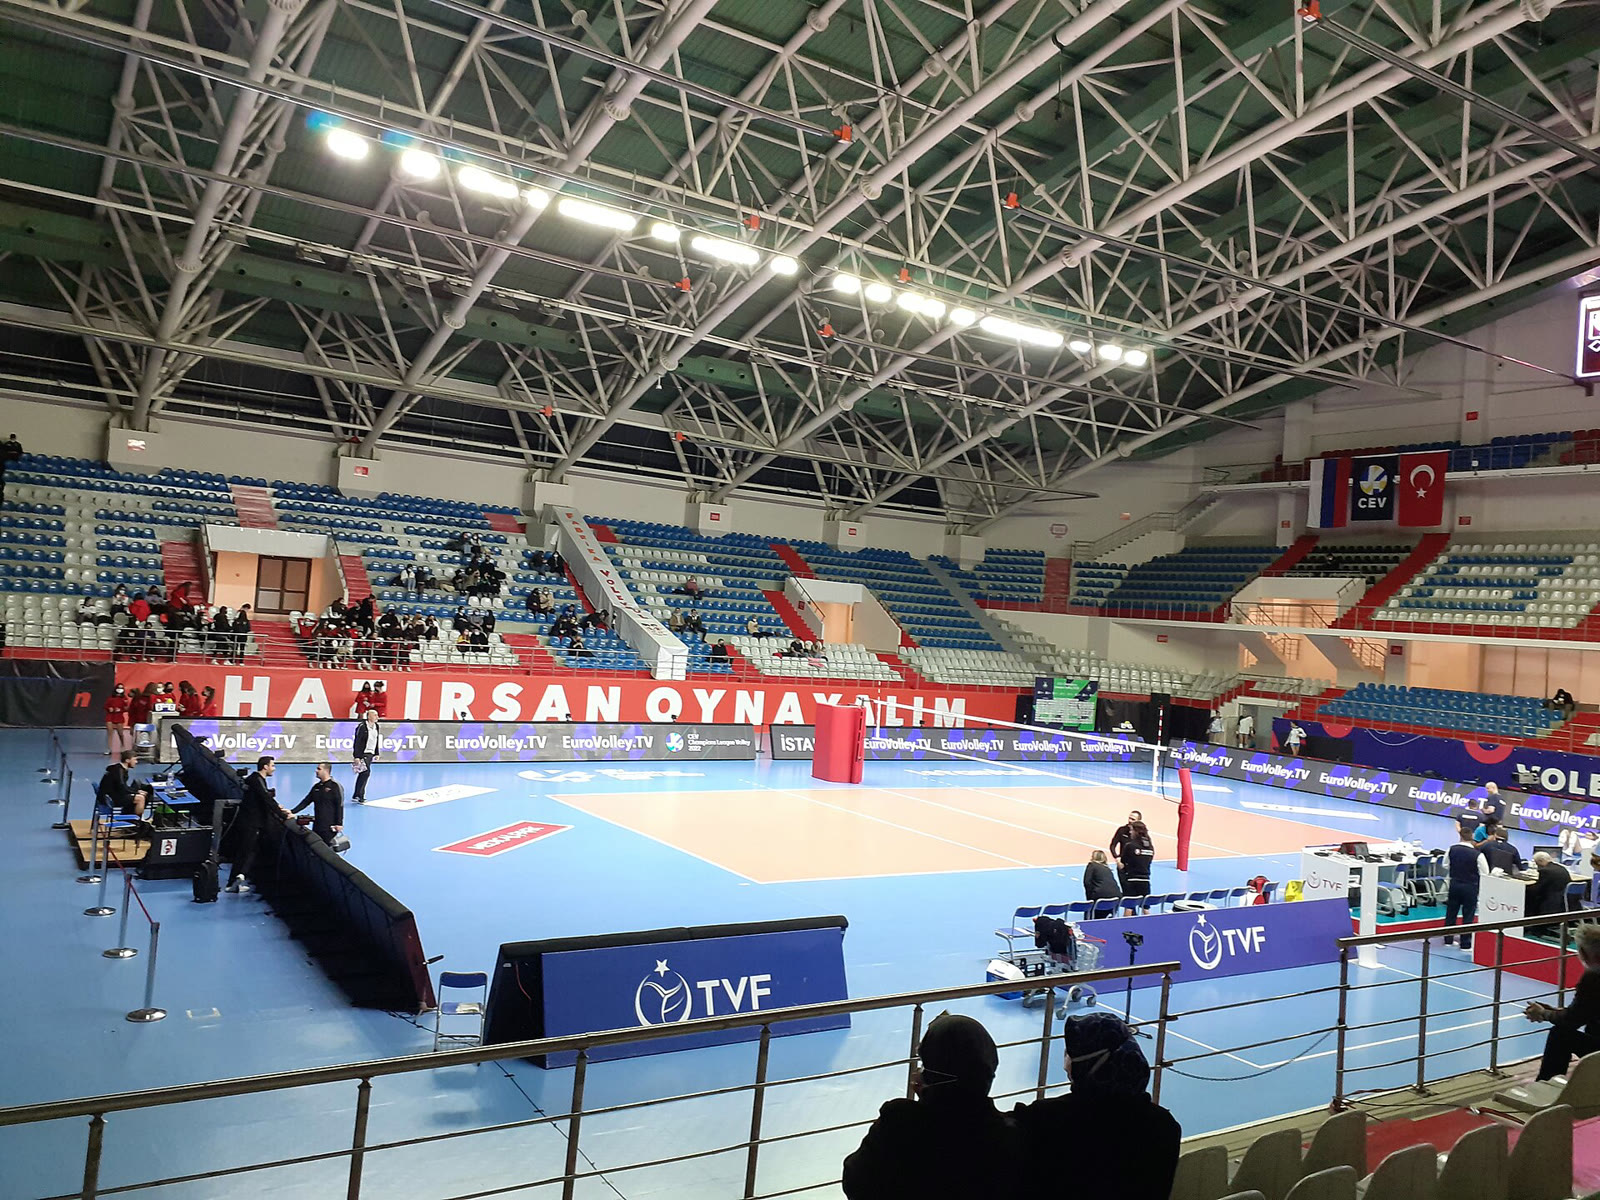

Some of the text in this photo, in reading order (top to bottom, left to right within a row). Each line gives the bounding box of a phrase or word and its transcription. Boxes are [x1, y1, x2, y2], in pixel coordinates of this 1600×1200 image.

[1358, 497, 1387, 508] CEV
[171, 733, 653, 752] oVolley.TV Euroley.TV EuroVolley.TV EuroVolley.TV
[780, 733, 1136, 754] İSTA EuroVolley.TV EuroVolley.TV EuroVolley.TV EuroVolley.TV
[1170, 751, 1233, 767] EuoVolley.TV
[1240, 759, 1311, 780] EuroVolley.TV
[1319, 772, 1398, 794] EuroVolley.TV
[1322, 879, 1342, 891] TVF
[1500, 903, 1519, 913] TVF
[1222, 926, 1266, 956] TVF
[697, 974, 771, 1016] TVF
